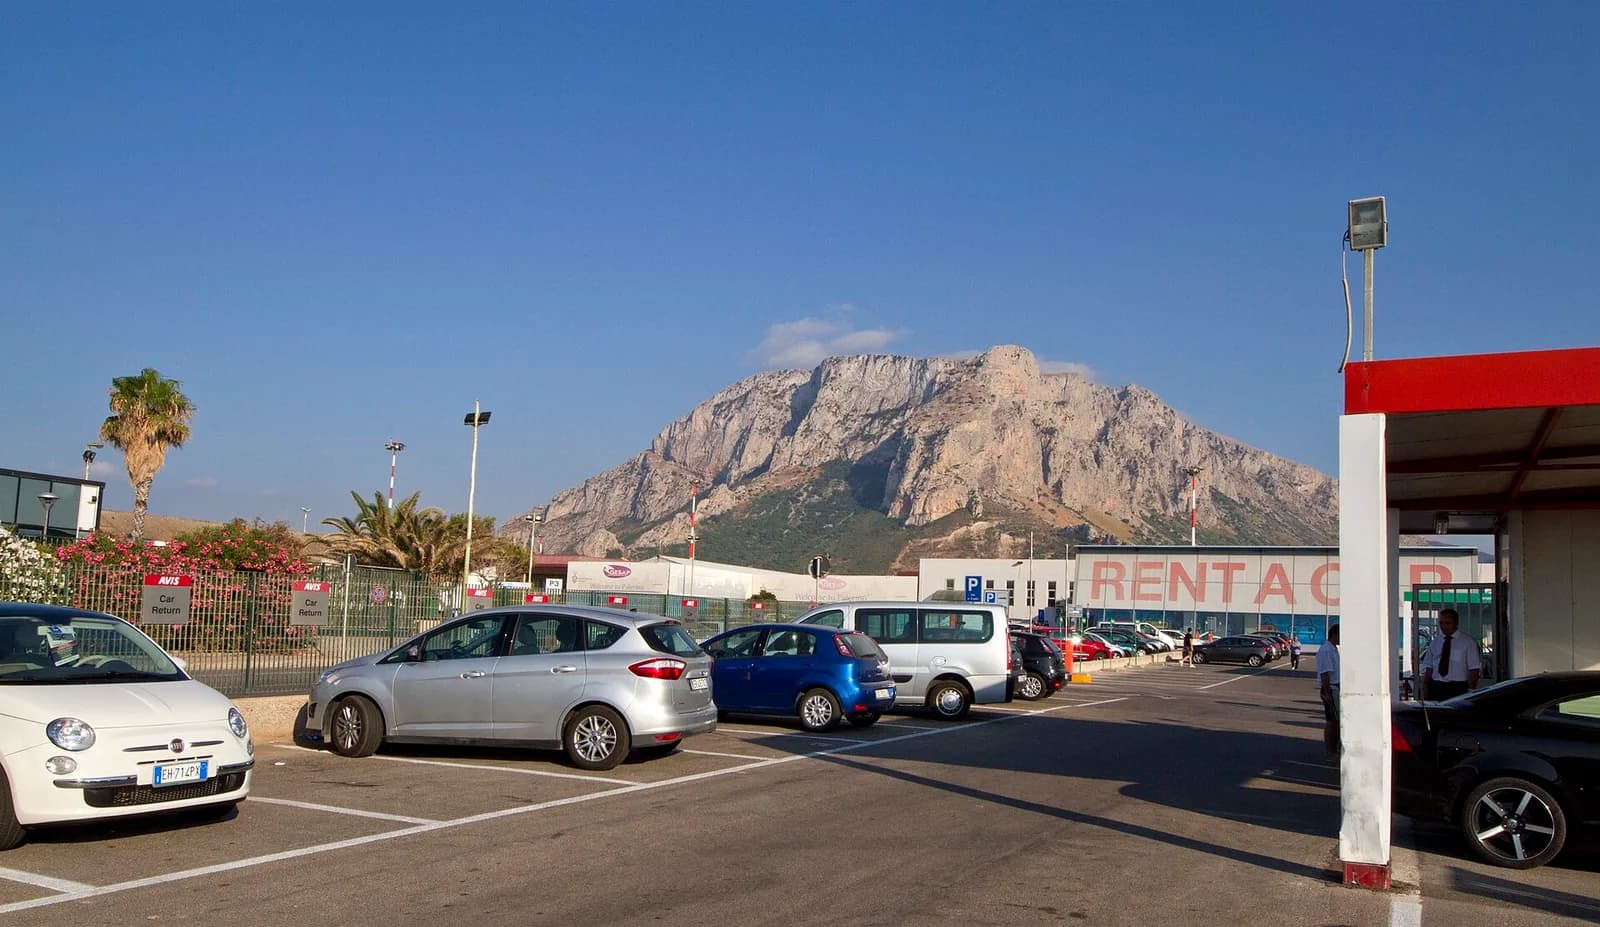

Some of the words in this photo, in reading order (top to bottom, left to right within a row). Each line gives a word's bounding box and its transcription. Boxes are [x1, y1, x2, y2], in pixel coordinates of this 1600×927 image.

[158, 576, 181, 585] AVIS
[968, 577, 979, 592] P
[1091, 561, 1246, 604] RENT
[1253, 562, 1298, 605] A
[304, 582, 322, 591] AVIS
[159, 594, 176, 604] Car
[986, 592, 995, 603] P
[304, 598, 318, 607] Car
[151, 606, 181, 615] Return
[298, 608, 322, 617] Return
